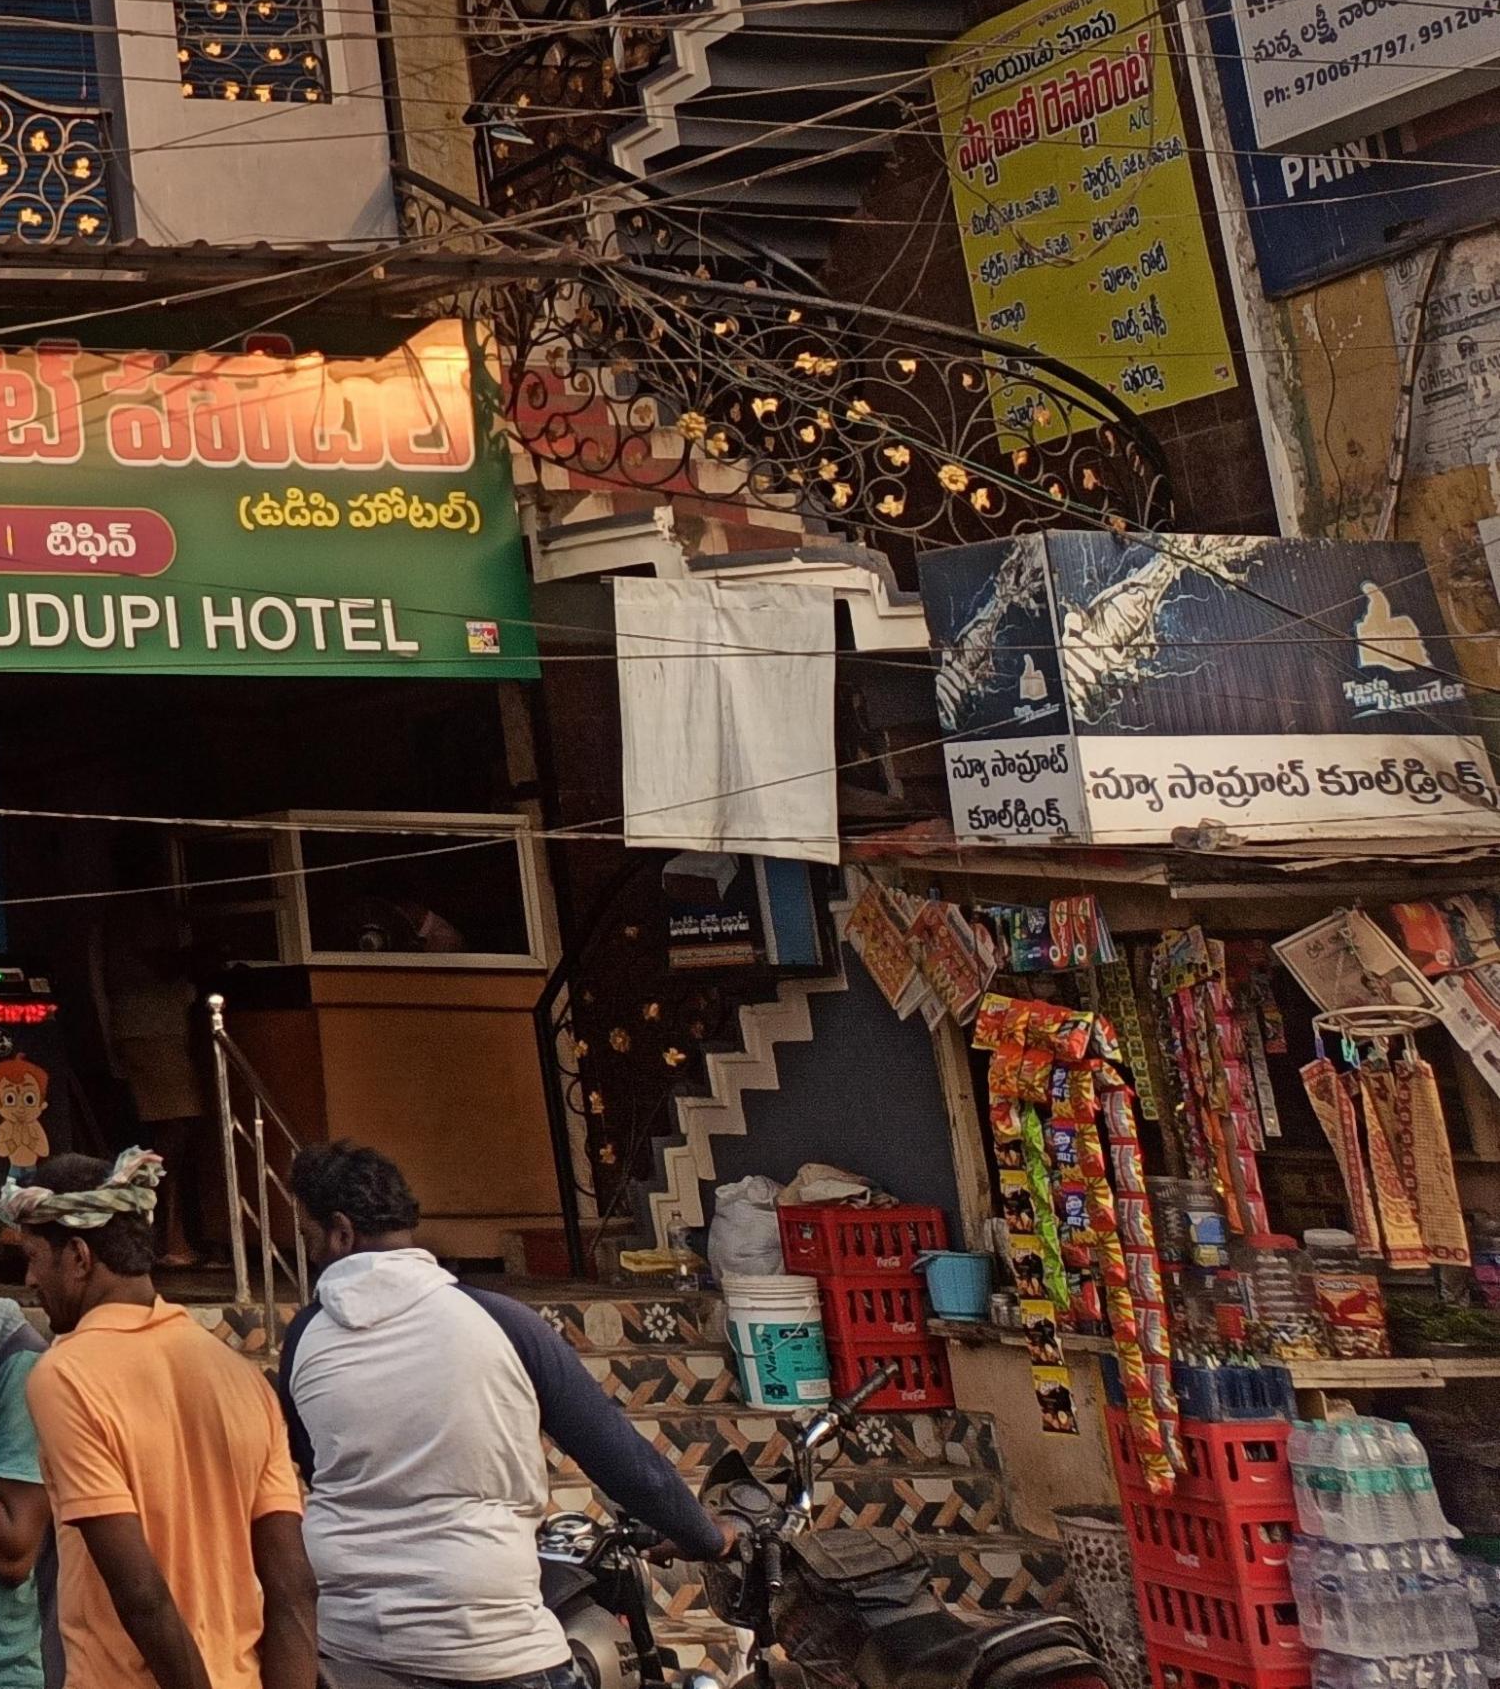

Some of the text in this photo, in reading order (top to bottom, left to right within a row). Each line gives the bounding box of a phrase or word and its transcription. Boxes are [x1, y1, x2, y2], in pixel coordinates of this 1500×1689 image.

[1263, 85, 1292, 108] Ph:
[203, 596, 420, 656] HOTEL
[1372, 678, 1466, 710] Thunder
[951, 752, 989, 788] న్యూ
[1090, 766, 1160, 813] న్యూ
[1167, 757, 1311, 808] సామ్రాట్
